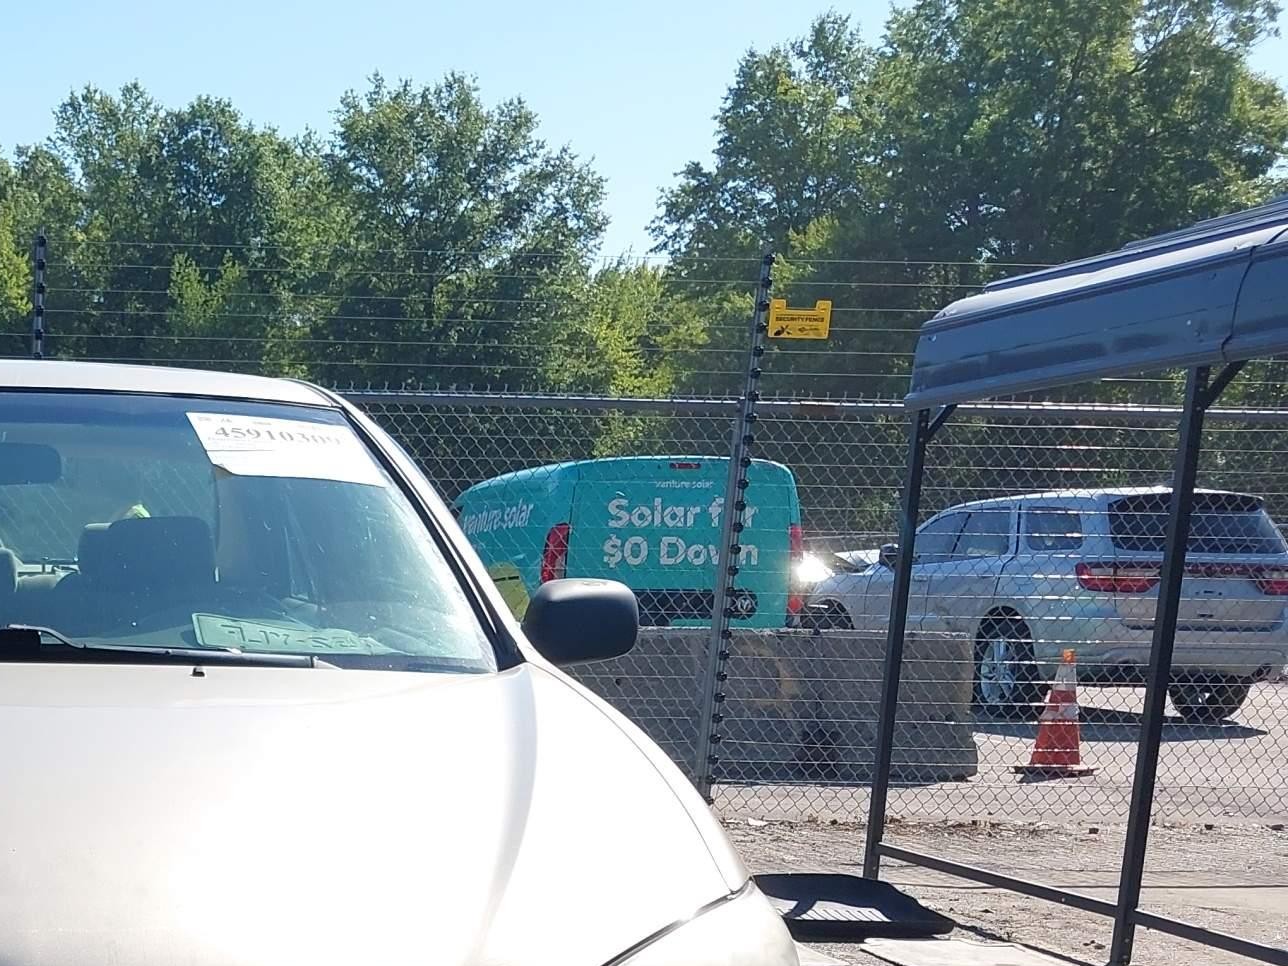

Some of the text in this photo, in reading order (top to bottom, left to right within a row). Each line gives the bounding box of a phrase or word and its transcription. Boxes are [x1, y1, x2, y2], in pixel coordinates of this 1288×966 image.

[608, 495, 759, 528] Solar fr
[603, 533, 649, 568] $0
